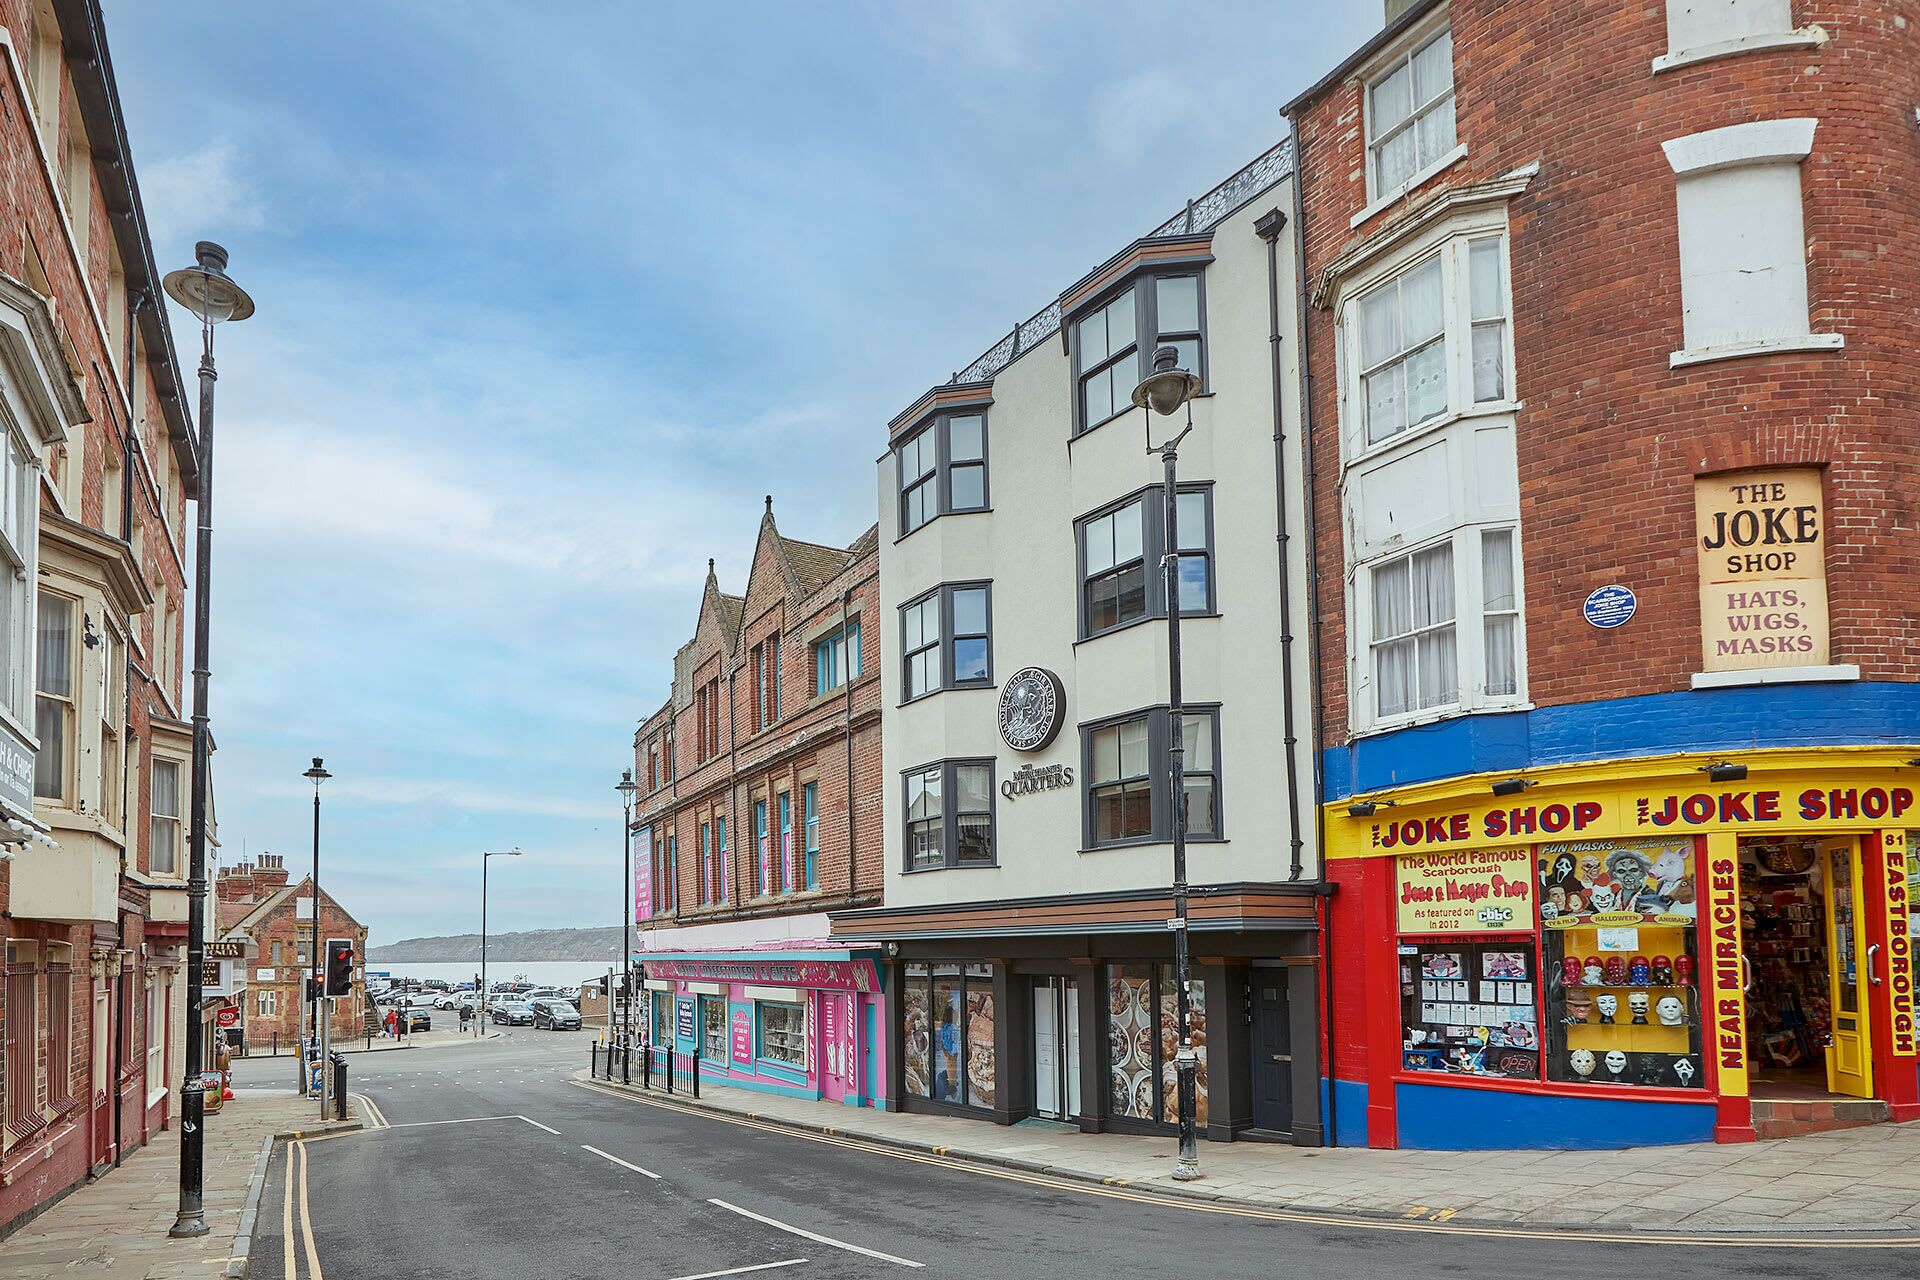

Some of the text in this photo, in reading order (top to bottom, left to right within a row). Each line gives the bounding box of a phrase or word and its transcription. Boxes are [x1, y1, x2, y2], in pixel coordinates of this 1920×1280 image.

[1731, 483, 1786, 504] THE
[1702, 505, 1819, 551] JOKE
[1728, 552, 1796, 574] SHOP
[1588, 594, 1632, 604] SCARBOROUGH
[1727, 590, 1806, 609] HATS,
[1727, 612, 1807, 632] WIGS,
[1716, 636, 1813, 656] MASKS
[6, 747, 12, 770] &
[13, 753, 32, 783] CHIPS
[1001, 767, 1074, 800] QUARTERS
[1637, 787, 1914, 826] THE JOKE SHOP
[1382, 814, 1470, 848] JOKE
[1484, 802, 1602, 837] SHOP
[1542, 843, 1568, 854] FUN
[1885, 834, 1903, 846] 81
[1400, 849, 1526, 870] The World Famous
[1422, 863, 1502, 878] Scarborough
[1401, 881, 1433, 904] Joke
[1446, 878, 1490, 903] Magic
[1492, 874, 1529, 901] Shop
[1414, 909, 1425, 918] As
[1426, 908, 1462, 918] featured
[1464, 909, 1474, 917] on
[1438, 920, 1459, 929] 2012
[1886, 852, 1913, 1052] EASTBOROUGH
[699, 964, 758, 980] CONFECTIONERY
[769, 966, 799, 981] GIFTS
[1712, 859, 1743, 1069] NEAR MIRACLES
[1500, 1056, 1537, 1072] OPEN
